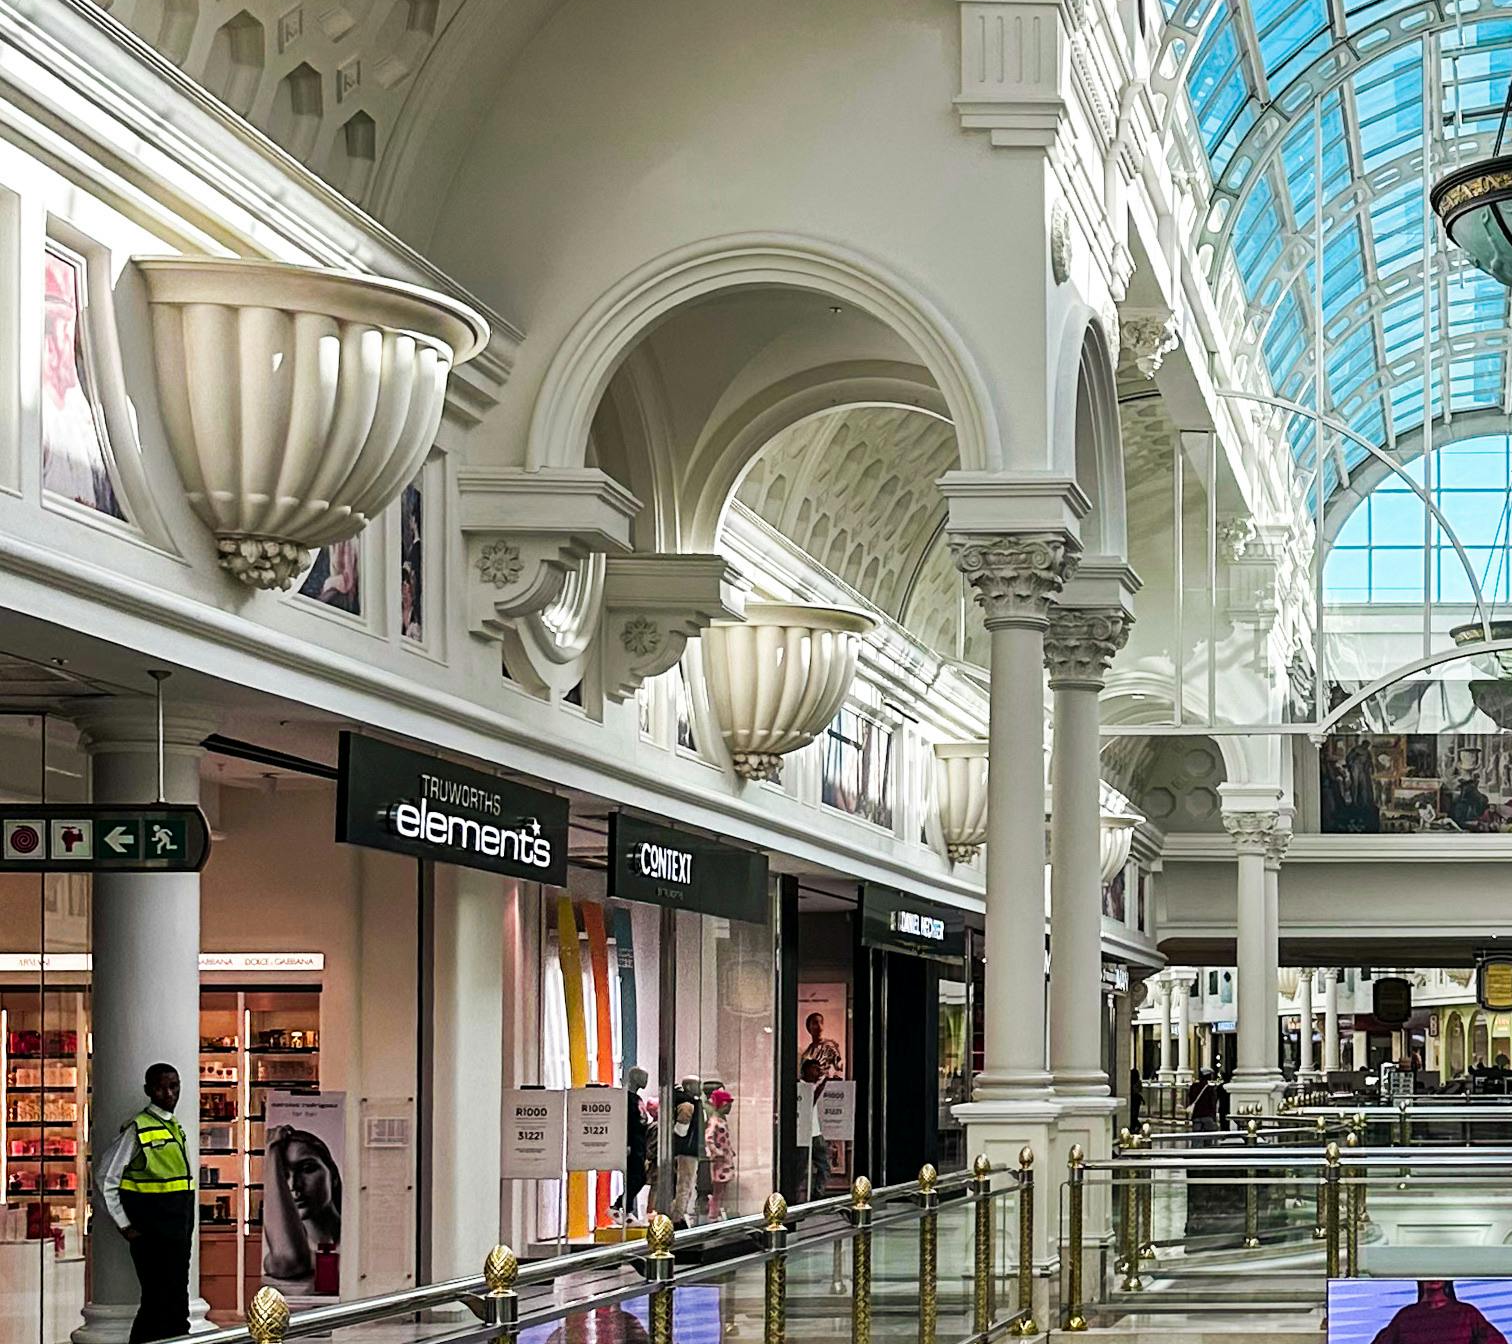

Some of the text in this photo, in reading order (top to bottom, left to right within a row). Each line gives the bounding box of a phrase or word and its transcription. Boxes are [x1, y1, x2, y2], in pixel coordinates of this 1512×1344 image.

[421, 773, 501, 816] TRUWORTHS
[396, 797, 551, 868] elements
[639, 842, 692, 885] CONTEXT
[515, 1107, 548, 1117] R1000
[581, 1104, 611, 1113] R1000
[583, 1126, 608, 1135] 31221
[517, 1131, 544, 1141] 31221
